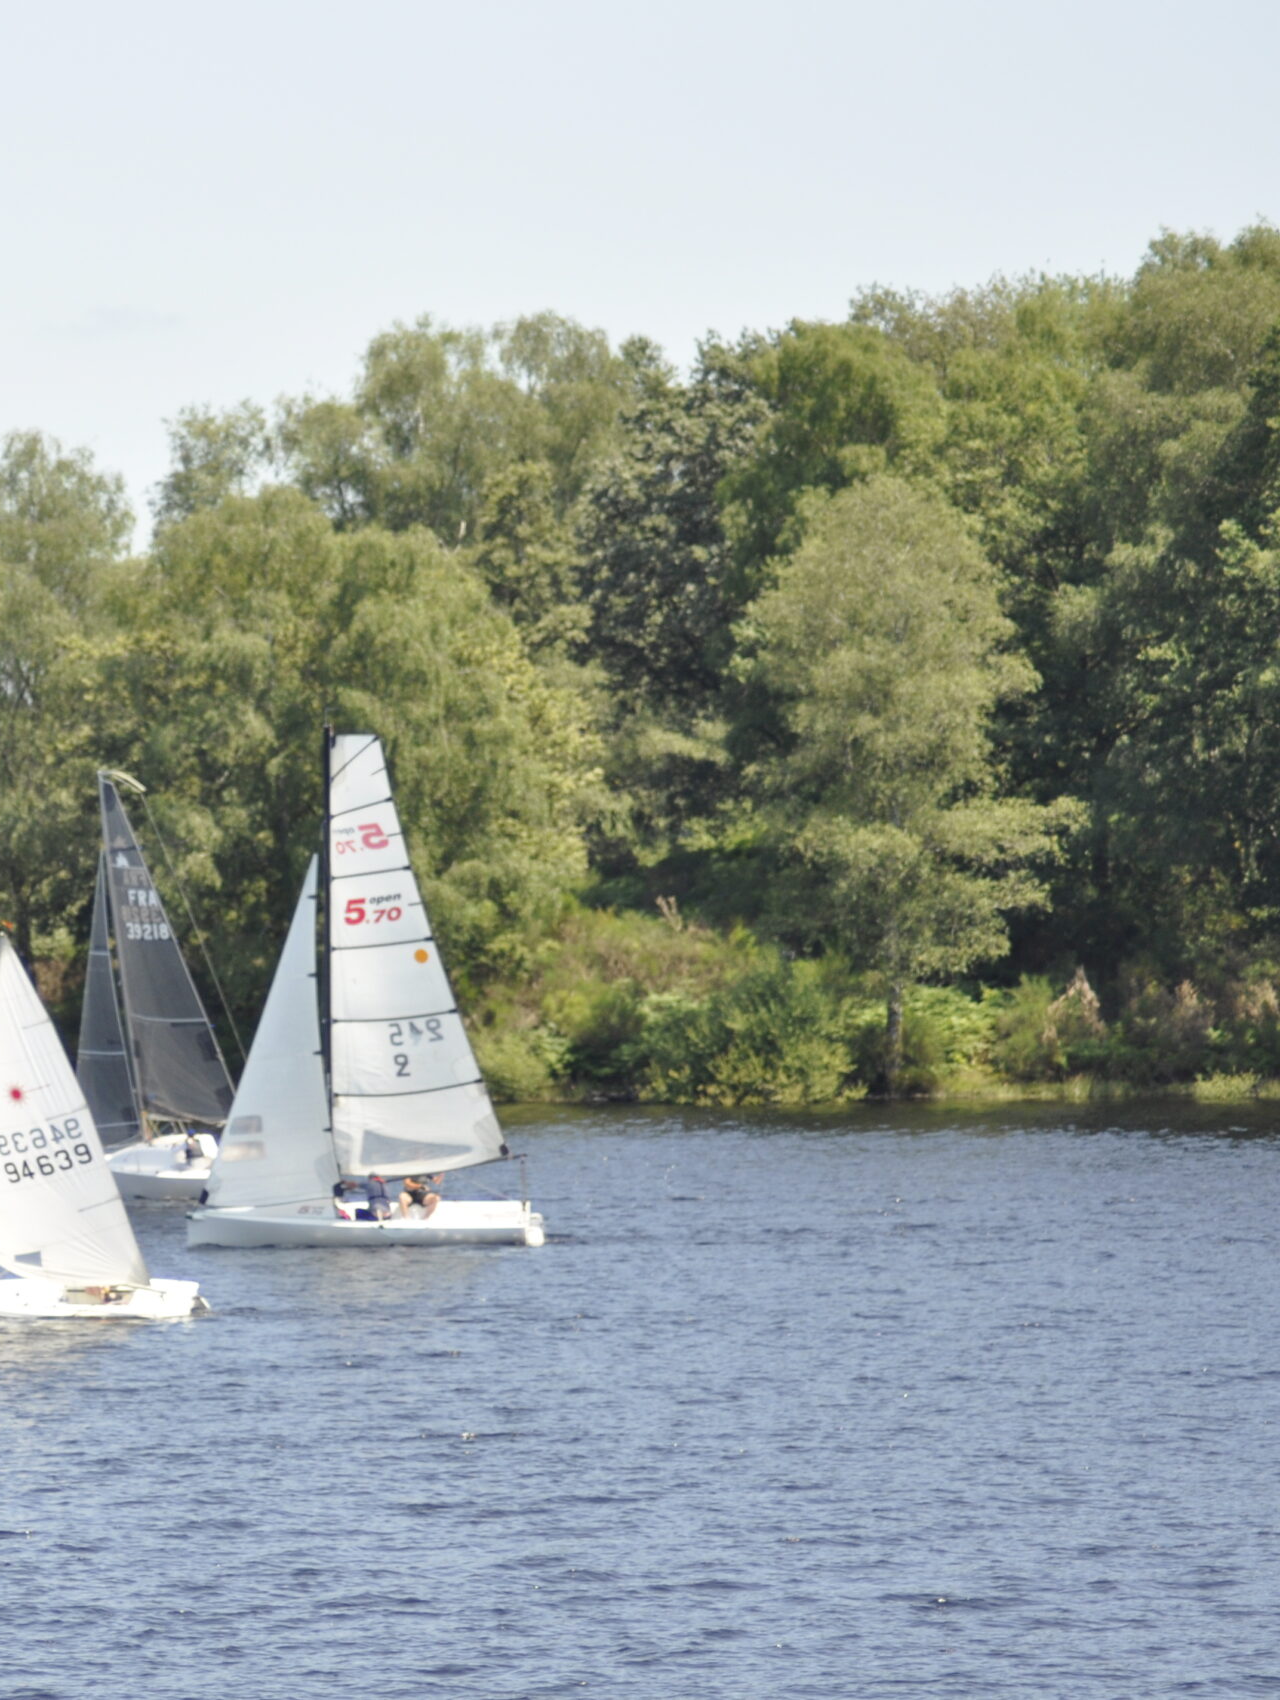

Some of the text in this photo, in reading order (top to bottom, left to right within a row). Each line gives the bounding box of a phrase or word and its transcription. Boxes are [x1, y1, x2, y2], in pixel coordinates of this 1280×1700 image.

[127, 889, 158, 907] FRA
[369, 893, 401, 904] open
[343, 898, 402, 926] 5.70
[393, 1053, 411, 1077] 2
[4, 1143, 92, 1183] 94639
